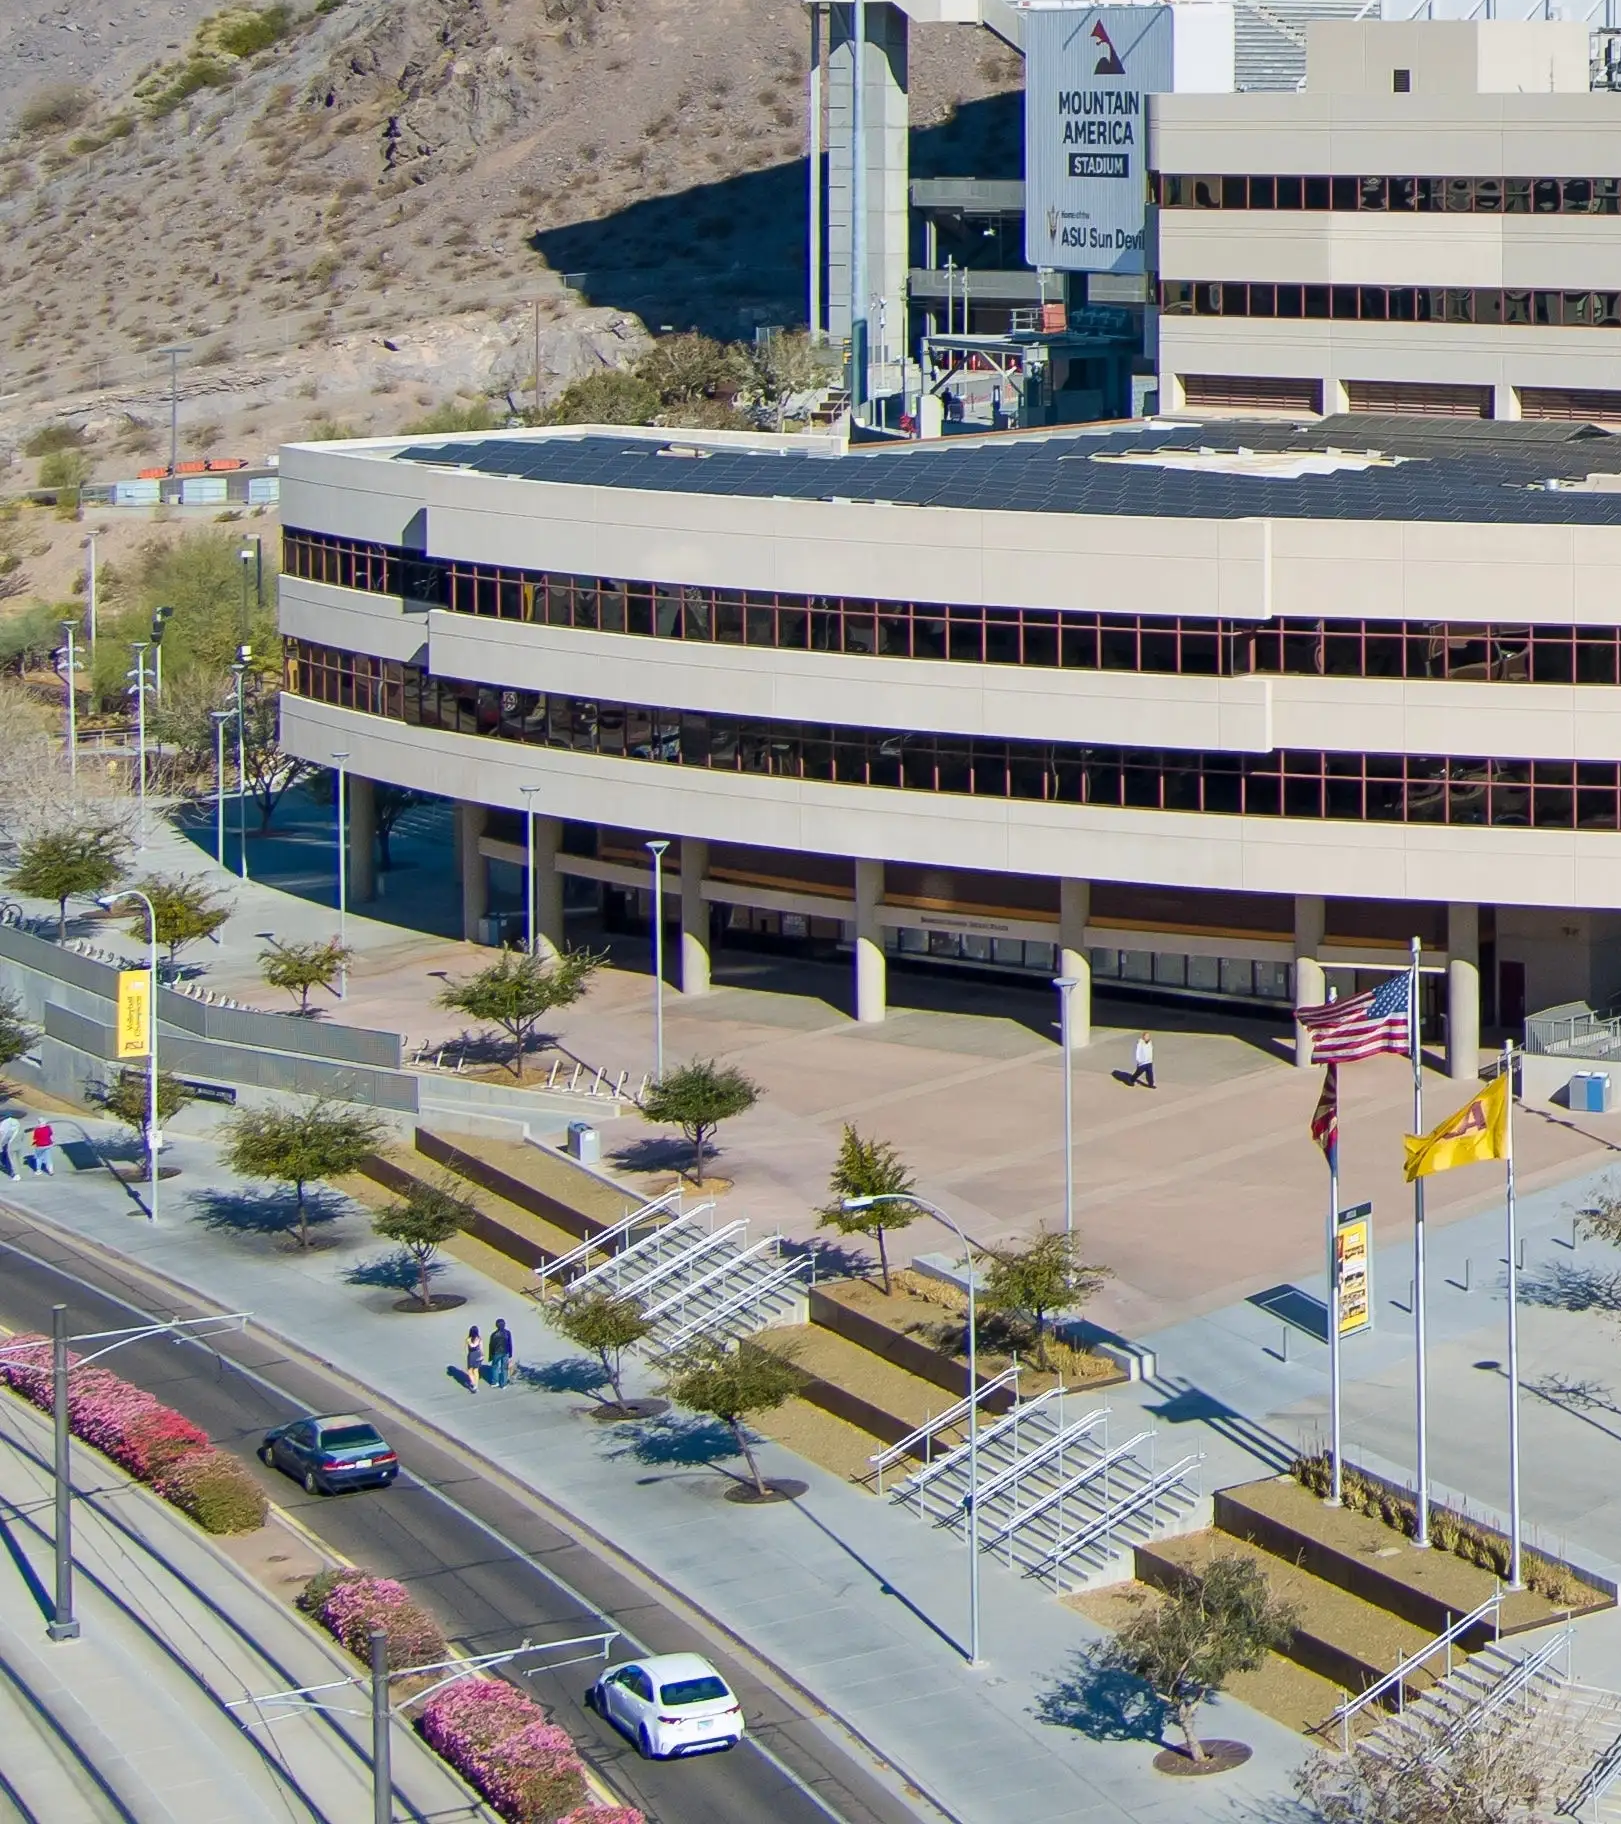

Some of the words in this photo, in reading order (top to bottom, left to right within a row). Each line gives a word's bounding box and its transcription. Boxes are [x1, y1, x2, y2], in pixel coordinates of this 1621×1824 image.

[1059, 90, 1140, 115] MOUNTAIN
[1062, 120, 1135, 145] AMERICA
[1074, 156, 1124, 174] STADIUM
[1061, 226, 1087, 247] ASU
[1089, 227, 1113, 249] Sun
[1115, 228, 1145, 250] Devil
